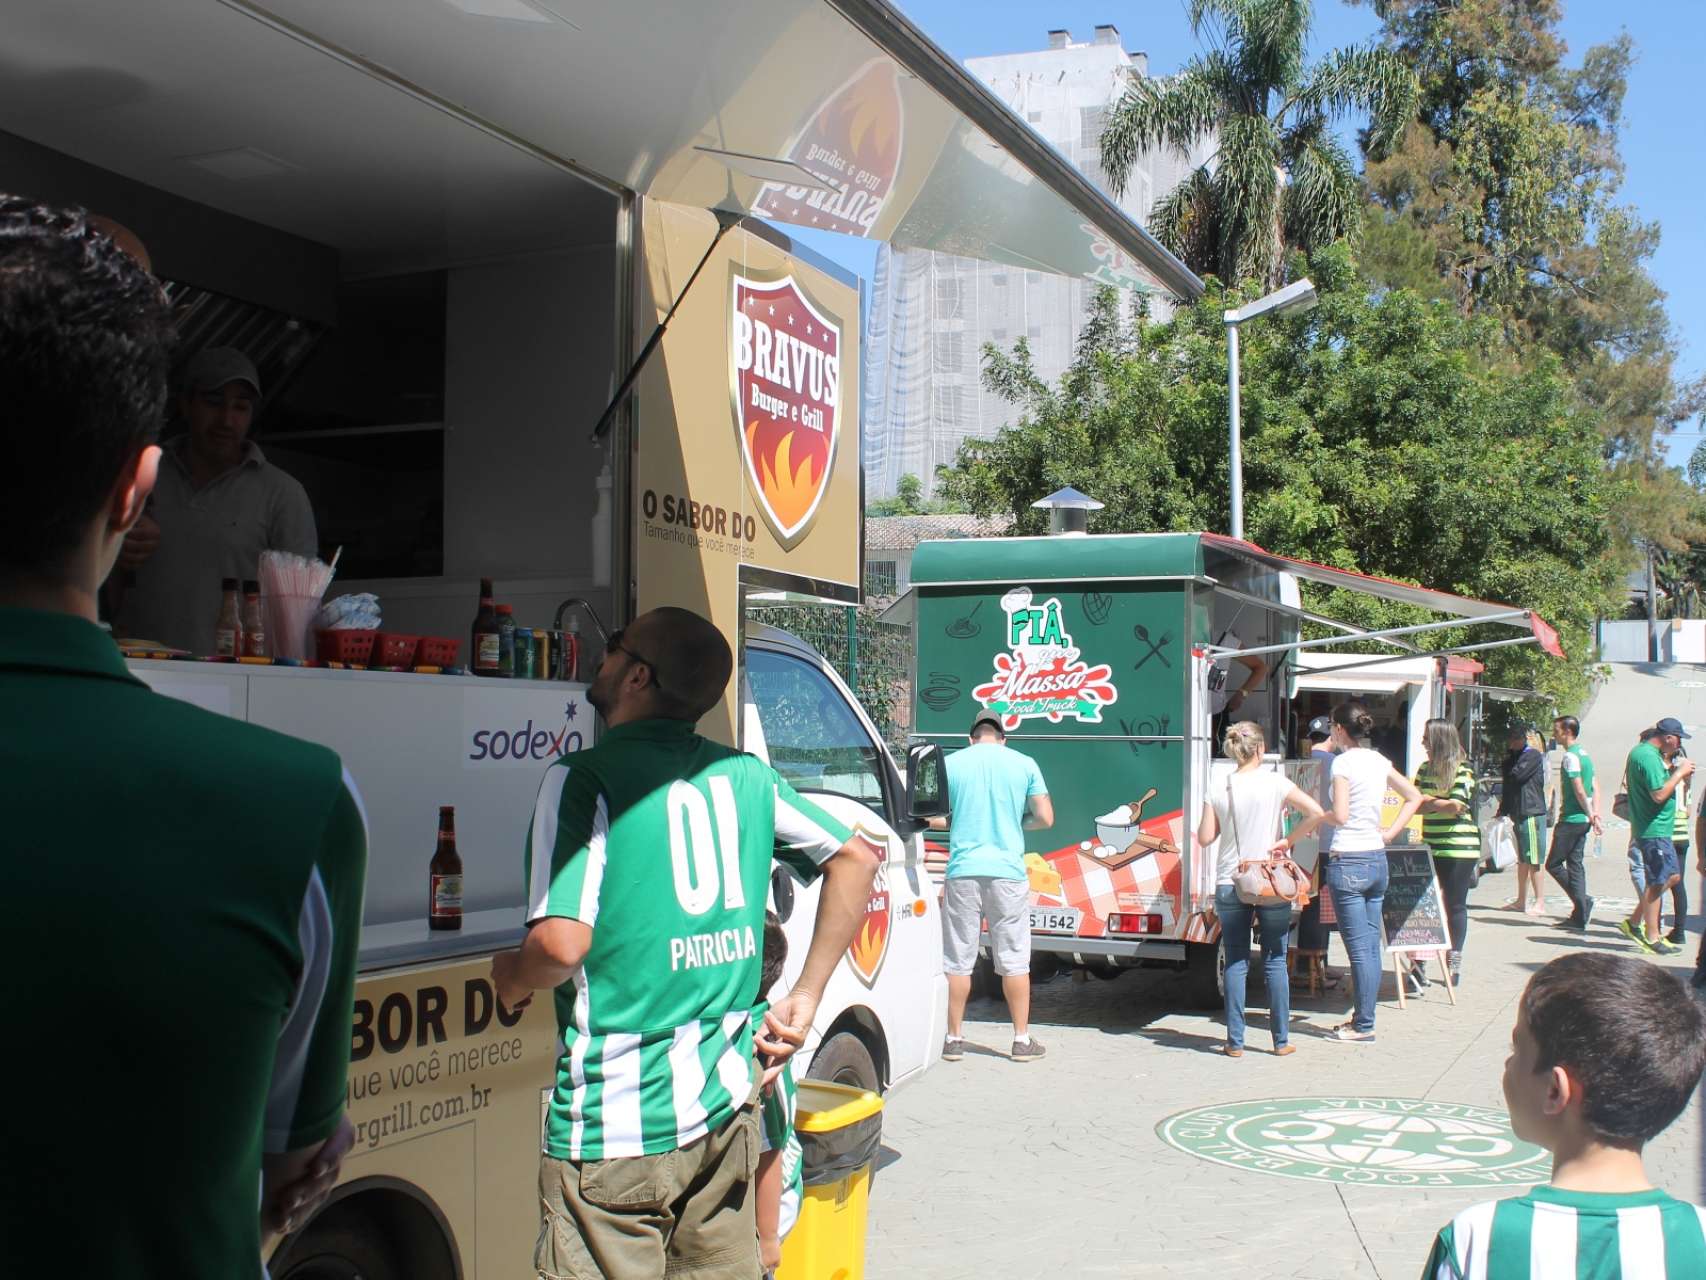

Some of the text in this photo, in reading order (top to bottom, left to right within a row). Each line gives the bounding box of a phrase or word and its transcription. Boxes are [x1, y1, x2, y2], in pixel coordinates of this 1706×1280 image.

[735, 310, 838, 407] BRAVUS
[751, 383, 824, 432] Burger e Grill
[643, 489, 756, 542] O SABOR DO
[643, 520, 685, 544] Tamanho
[687, 534, 704, 550] que
[991, 663, 1087, 698] Massa
[1005, 696, 1079, 714] Food Truck
[469, 719, 583, 761] sodexo
[1030, 914, 1075, 929] S-1542
[670, 925, 756, 972] PATRICIA
[350, 986, 449, 1063] BOR
[389, 1050, 441, 1090] você
[448, 1038, 522, 1076] merece
[353, 1084, 492, 1147] rgrill.com.br
[1178, 1112, 1235, 1138] CLUB
